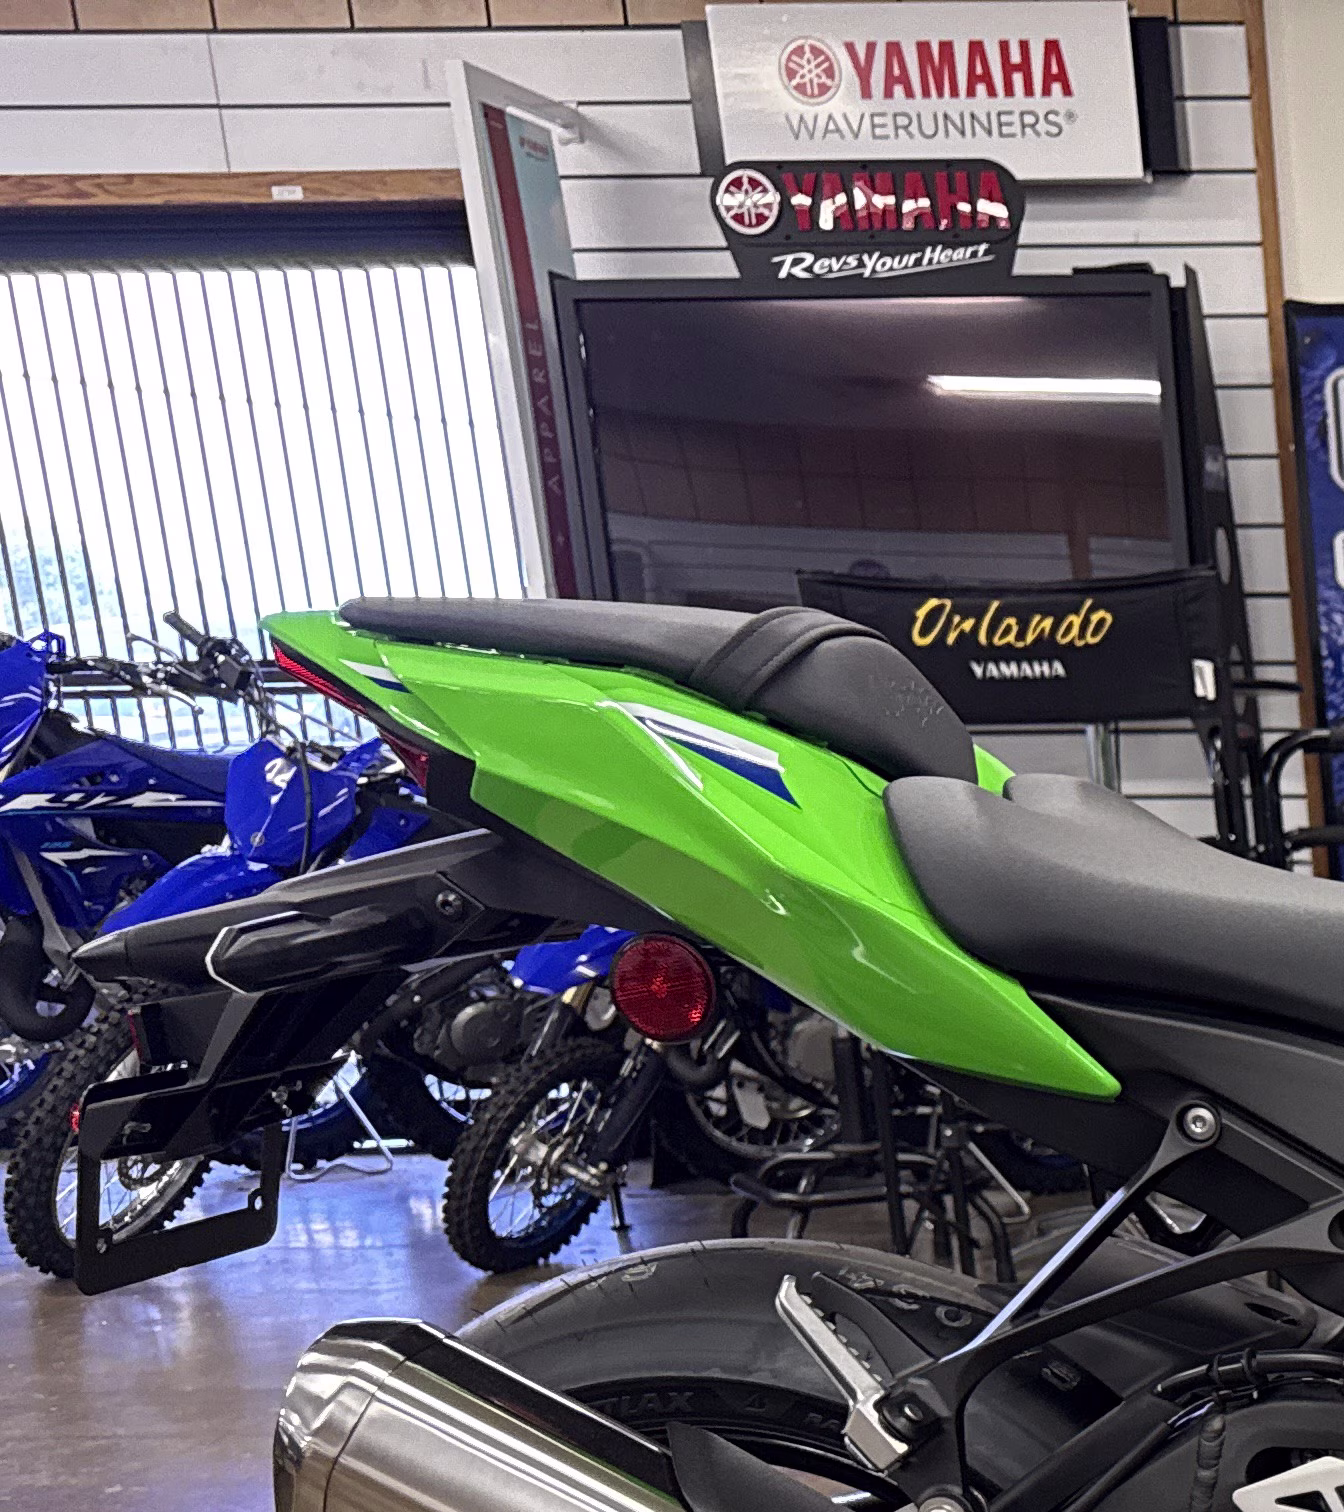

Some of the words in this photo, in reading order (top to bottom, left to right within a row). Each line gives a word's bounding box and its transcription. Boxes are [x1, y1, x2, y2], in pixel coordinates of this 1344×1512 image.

[843, 39, 1075, 99] YAMAHA
[781, 170, 1011, 231] YAMAHA
[771, 251, 860, 279] Revs
[861, 246, 925, 277] Your
[923, 243, 991, 268] Heart
[524, 319, 564, 496] APPAREL
[910, 597, 1114, 649] Orlando
[969, 658, 1068, 681] YAMAHA
